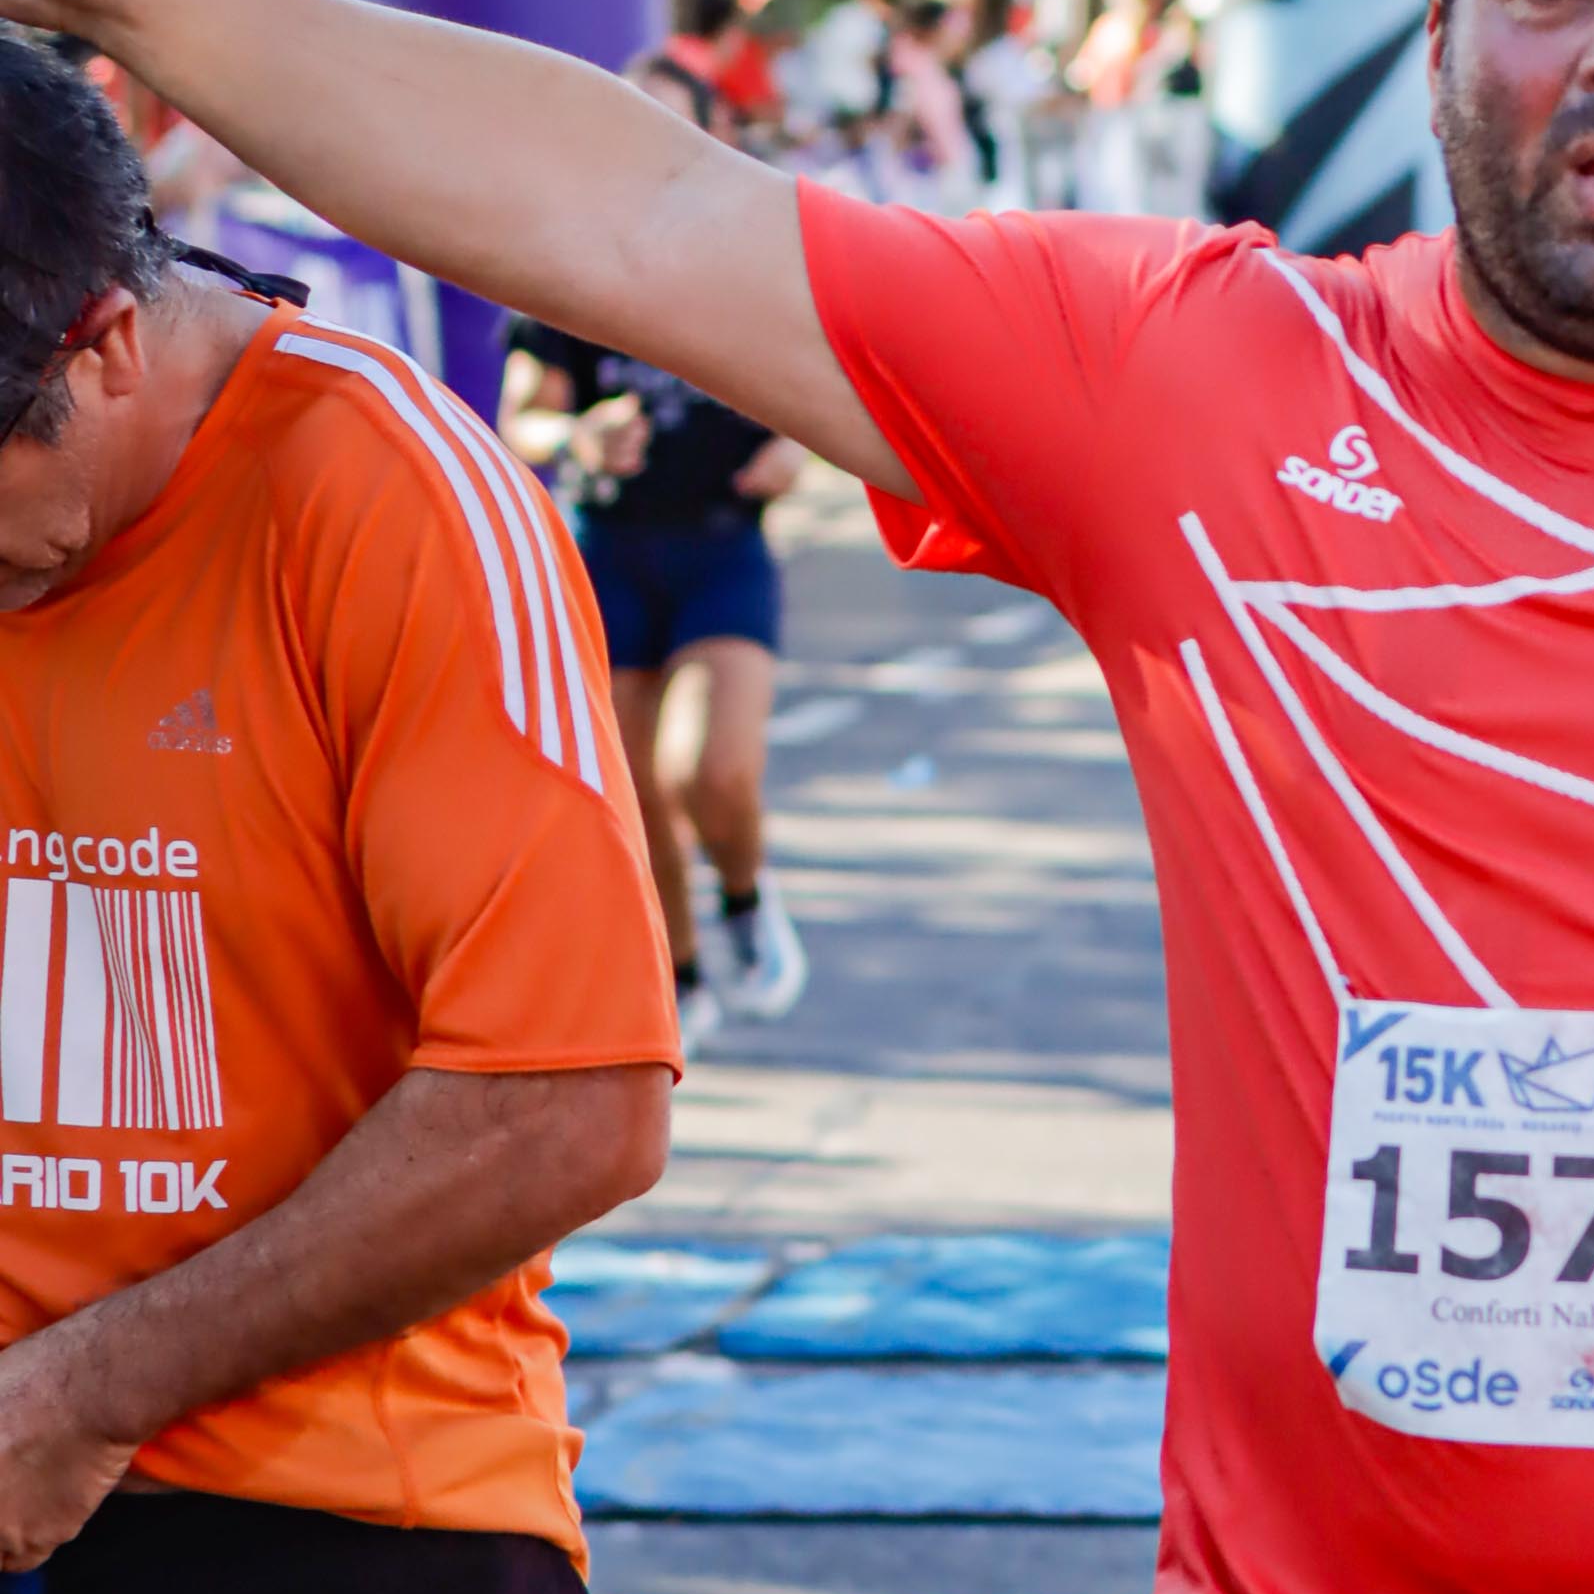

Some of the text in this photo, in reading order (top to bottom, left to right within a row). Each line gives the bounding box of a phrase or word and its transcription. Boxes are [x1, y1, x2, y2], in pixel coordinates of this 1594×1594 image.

[0, 826, 198, 881] ngcode
[1378, 1045, 1488, 1107] 15K
[0, 1153, 228, 1213] RIO 10K
[1431, 1295, 1542, 1327] Conforti
[1377, 1356, 1519, 1409] osde
